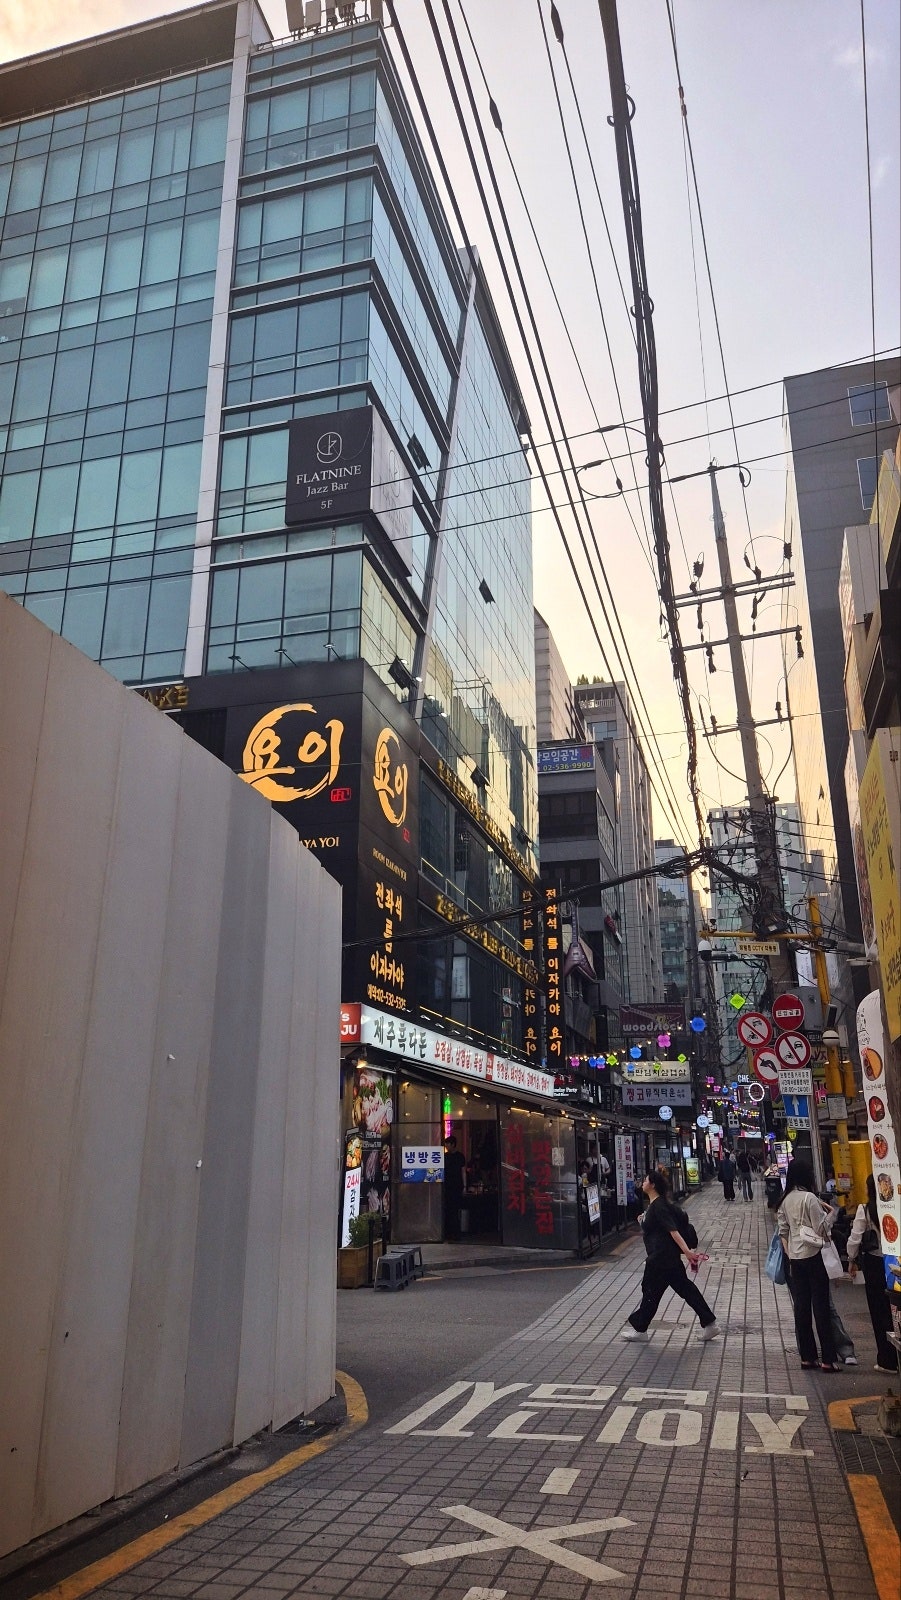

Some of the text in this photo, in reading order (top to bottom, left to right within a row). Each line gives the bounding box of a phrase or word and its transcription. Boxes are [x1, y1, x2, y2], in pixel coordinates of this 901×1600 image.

[295, 464, 362, 485] FLATNINE
[306, 481, 349, 498] Jazz Bar
[320, 499, 333, 510] 5F
[318, 836, 340, 848] YOI
[547, 937, 558, 950] 룸
[370, 950, 405, 991] 이자카야
[548, 957, 560, 1016] 이자카야
[622, 1021, 683, 1032] woodstock
[373, 1015, 428, 1060] 제주흑다돈
[548, 1026, 562, 1056] 요이
[404, 1151, 442, 1164] 냉방중
[383, 1380, 815, 1457] 진입금지
